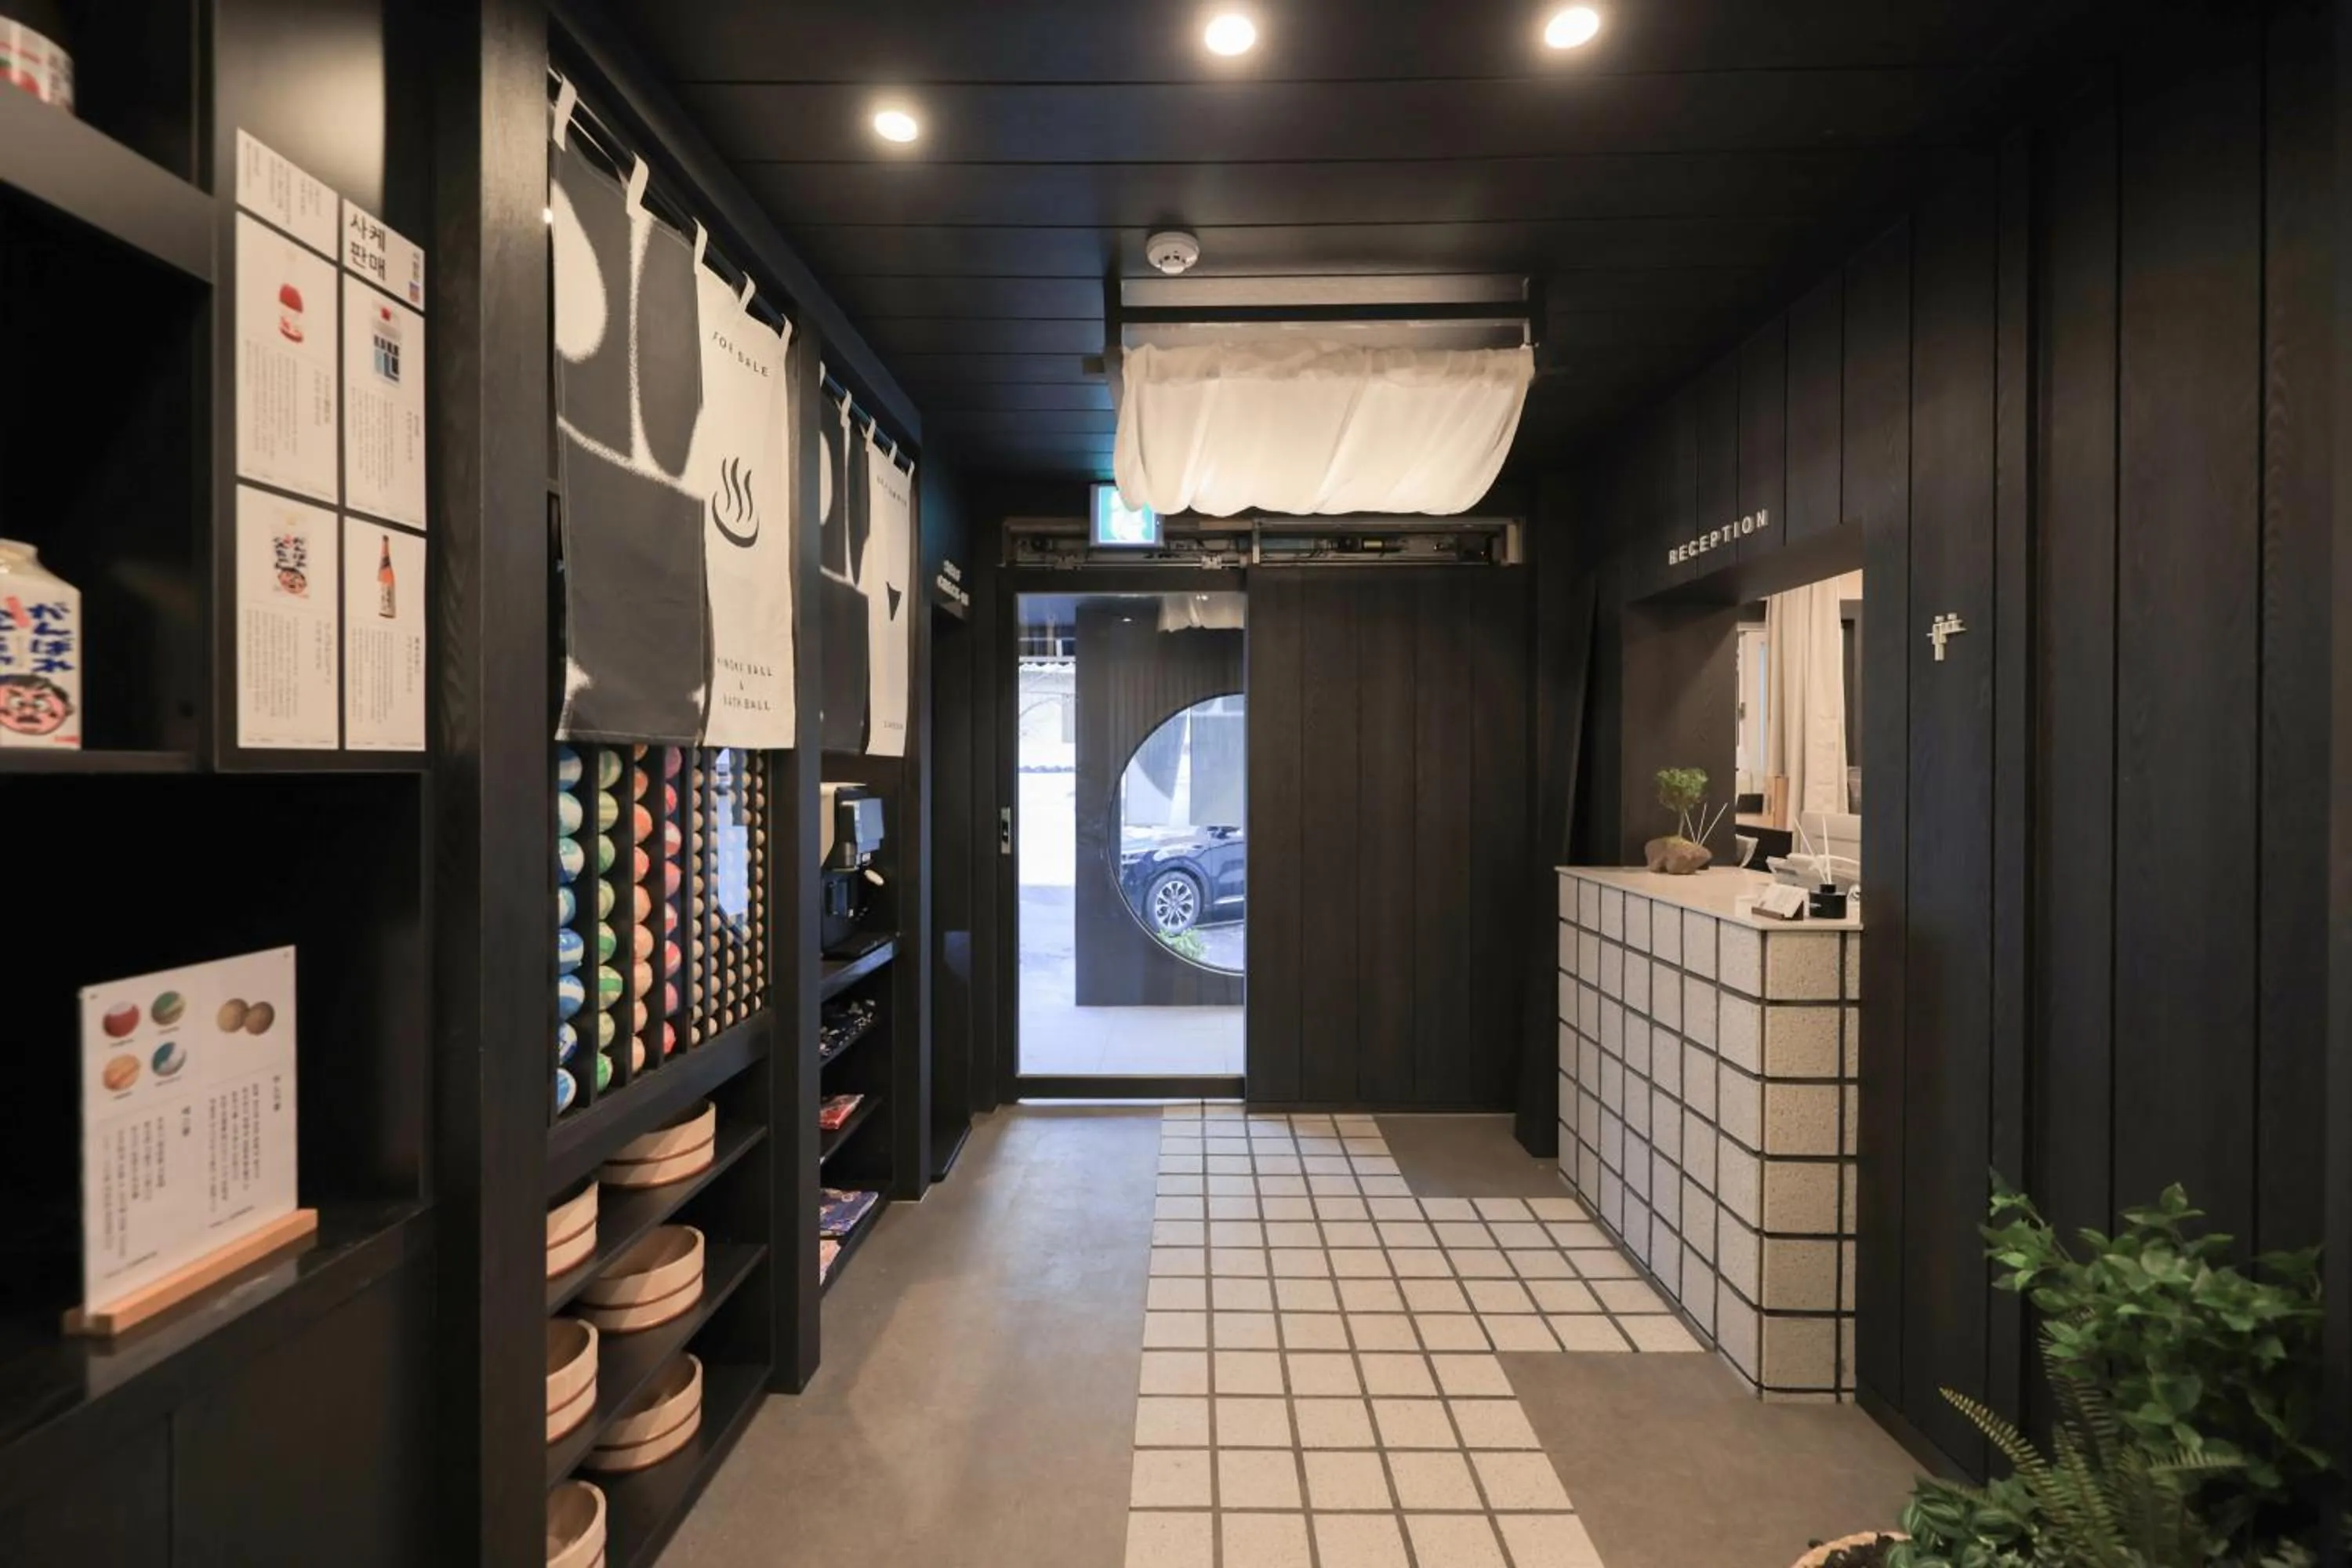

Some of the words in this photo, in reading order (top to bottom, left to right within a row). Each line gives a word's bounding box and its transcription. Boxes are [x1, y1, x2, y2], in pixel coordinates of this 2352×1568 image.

[350, 213, 385, 252] 사케
[350, 241, 385, 281] 판매
[1668, 508, 1769, 565] RECEPTION
